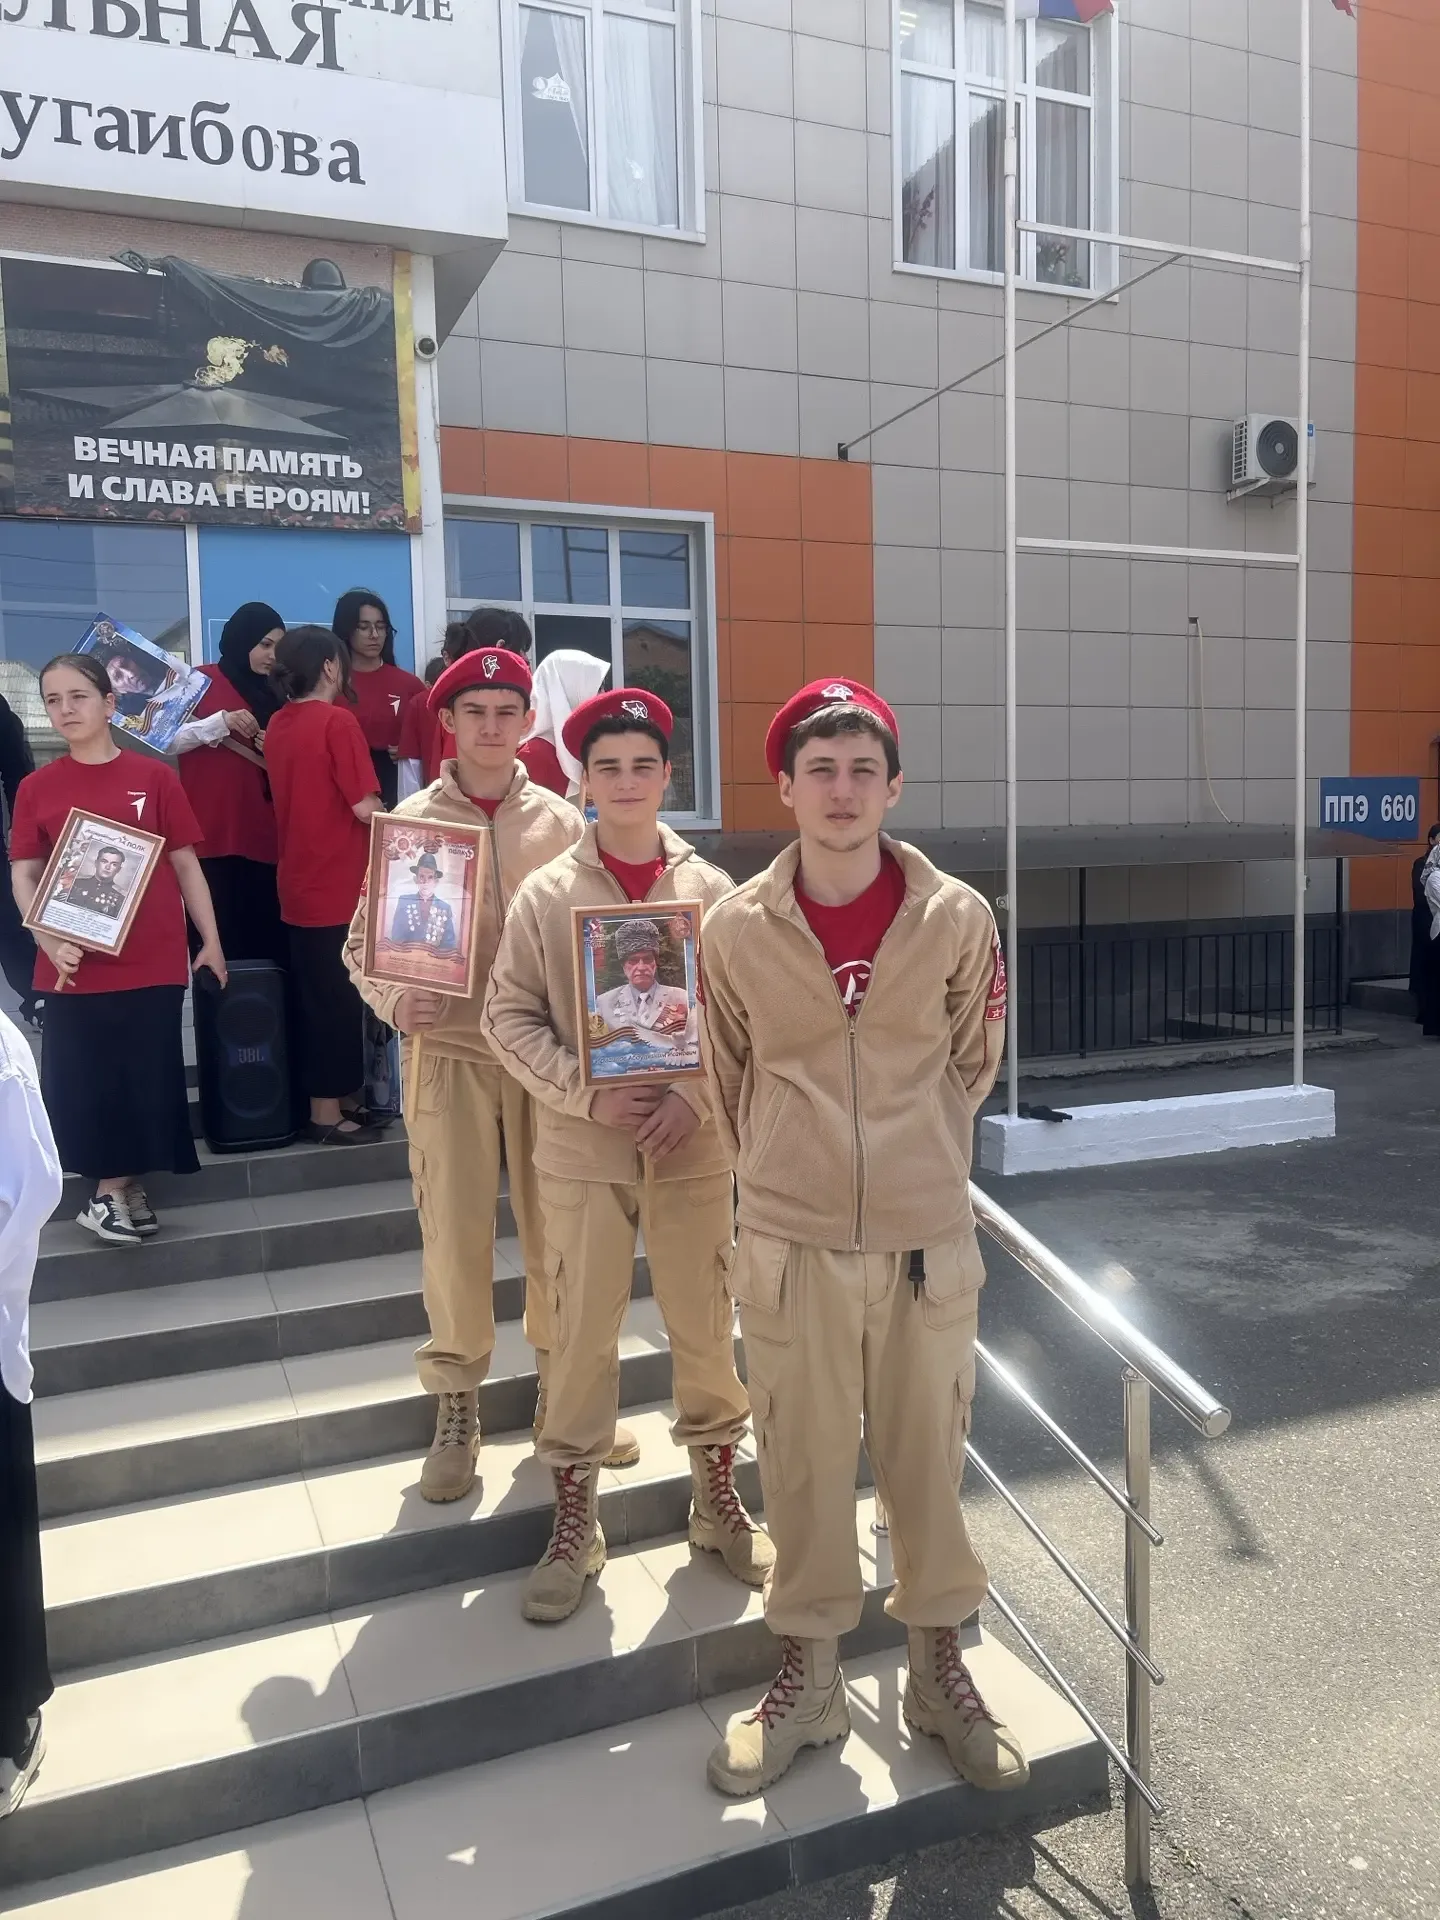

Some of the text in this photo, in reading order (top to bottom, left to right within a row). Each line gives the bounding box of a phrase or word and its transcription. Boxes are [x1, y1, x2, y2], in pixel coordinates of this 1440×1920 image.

[0, 90, 366, 185] угаибова
[74, 436, 363, 478] ВЕЧНАЯ ПАМЯТЬ
[68, 473, 370, 515] И СЛАВА ГЕРОЯМ!
[1325, 794, 1416, 823] ППЭ 660
[238, 1047, 264, 1064] JBL
